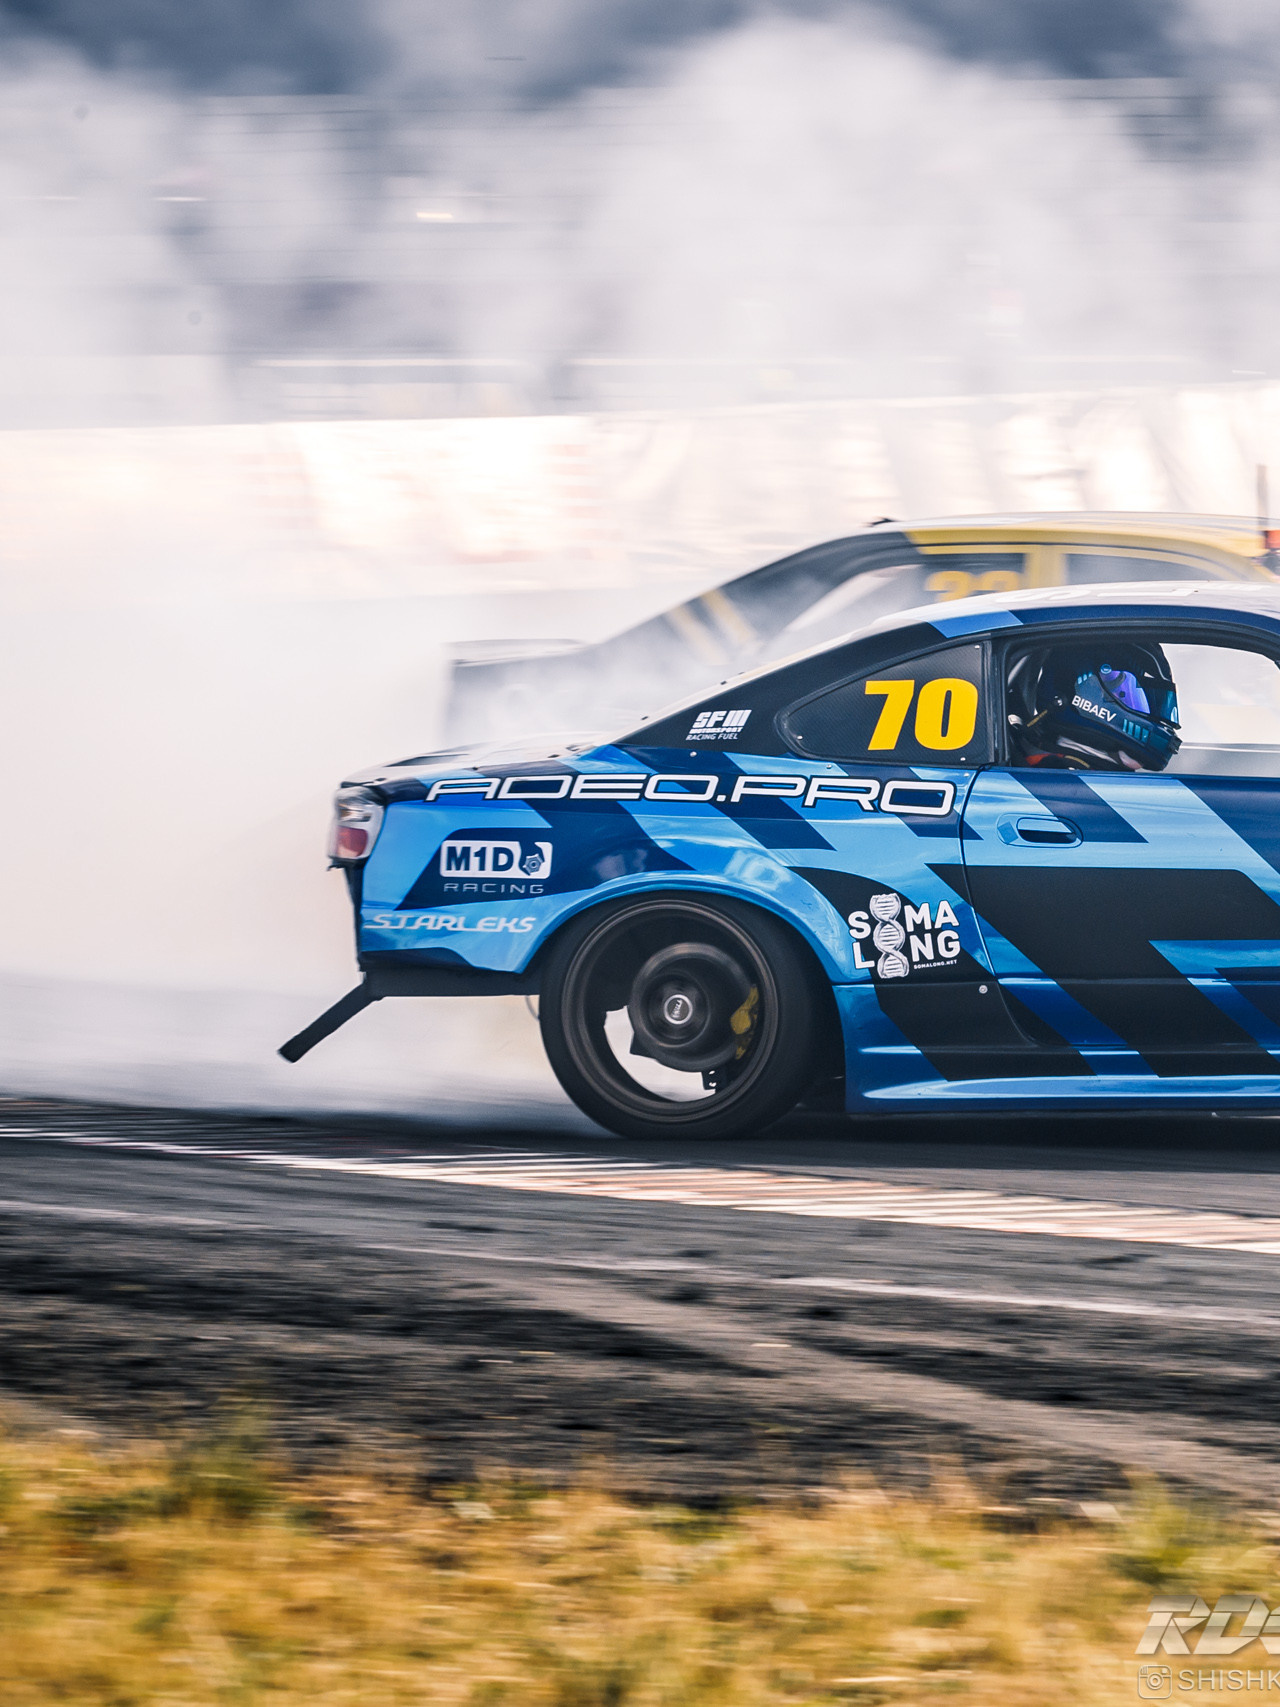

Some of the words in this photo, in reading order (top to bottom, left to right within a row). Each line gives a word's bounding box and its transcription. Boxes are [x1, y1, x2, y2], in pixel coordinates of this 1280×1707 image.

[864, 678, 978, 750] 70
[1072, 695, 1116, 722] BIBAEV
[446, 846, 514, 872] M1D
[443, 883, 544, 894] RACING
[363, 914, 536, 933] STARLEKS
[913, 959, 957, 970] SOMALONG.NET
